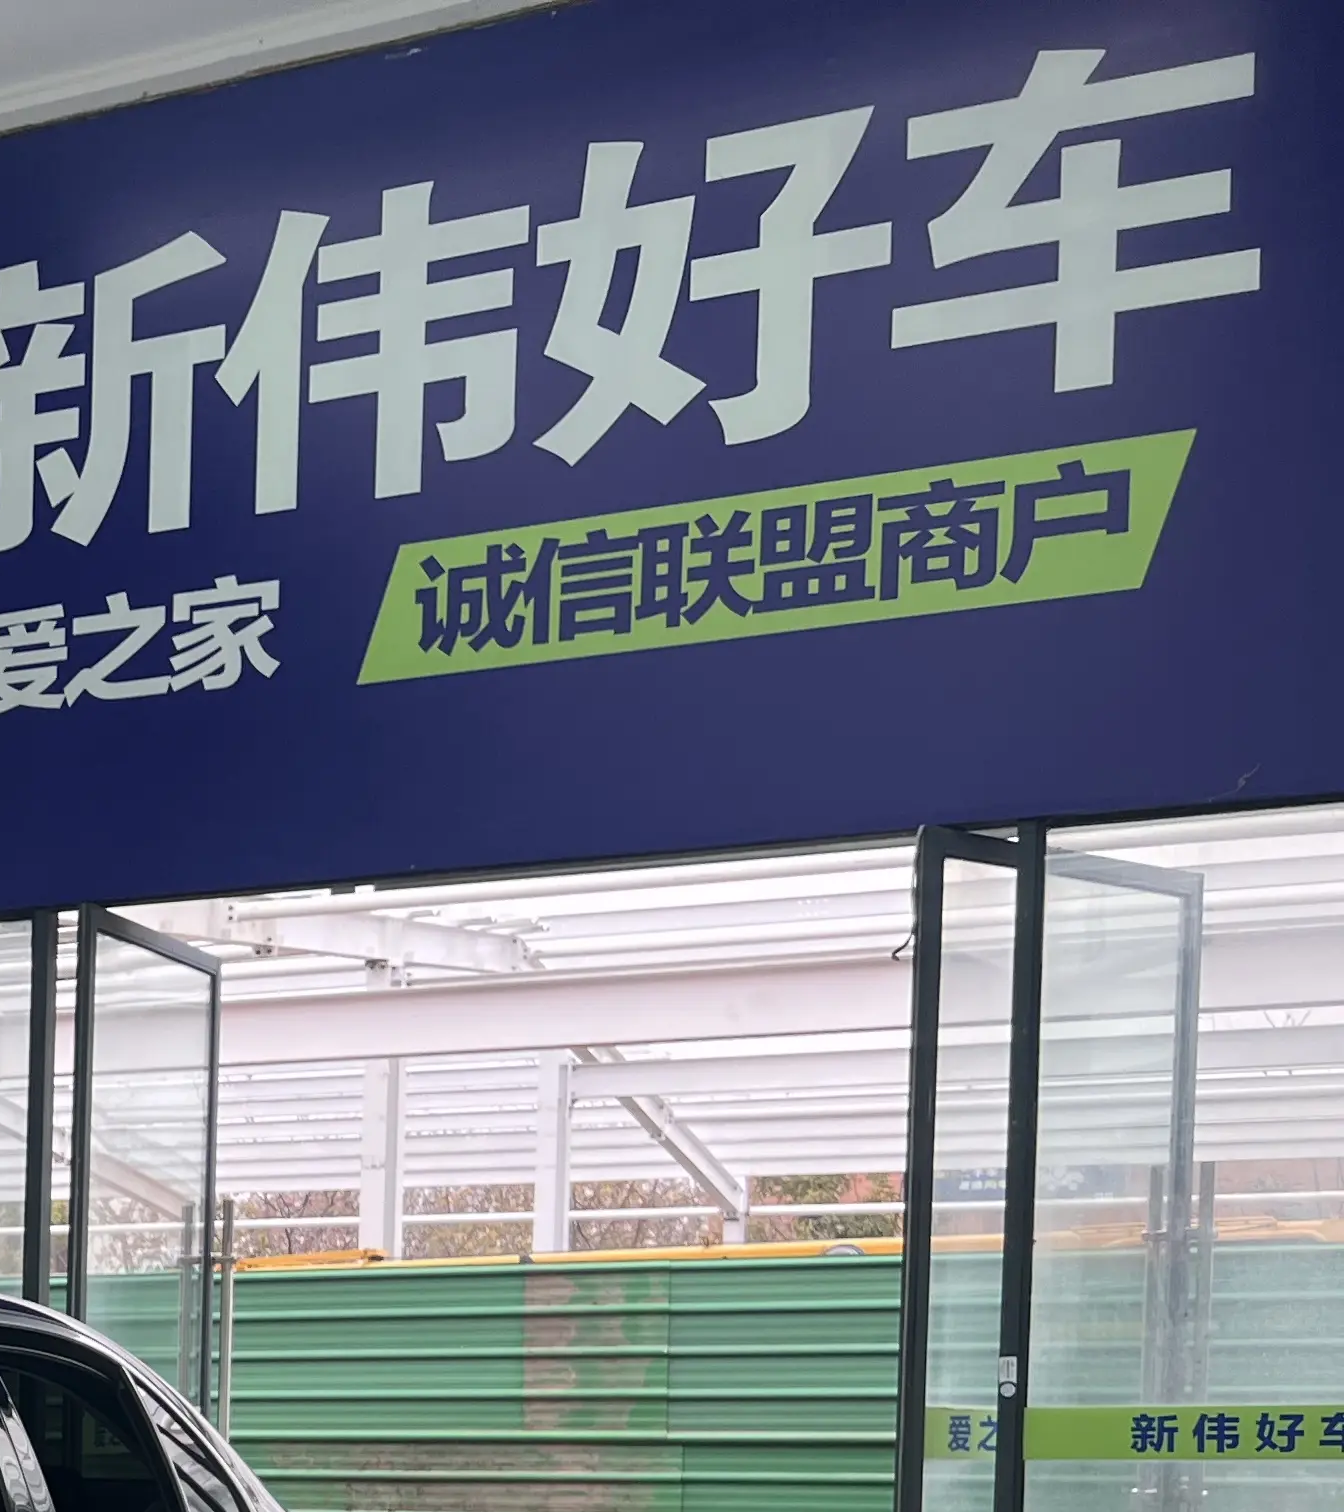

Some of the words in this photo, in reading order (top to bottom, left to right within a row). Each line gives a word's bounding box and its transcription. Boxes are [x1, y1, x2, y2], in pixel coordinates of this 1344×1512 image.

[415, 460, 1131, 659] 诚信联盟商户
